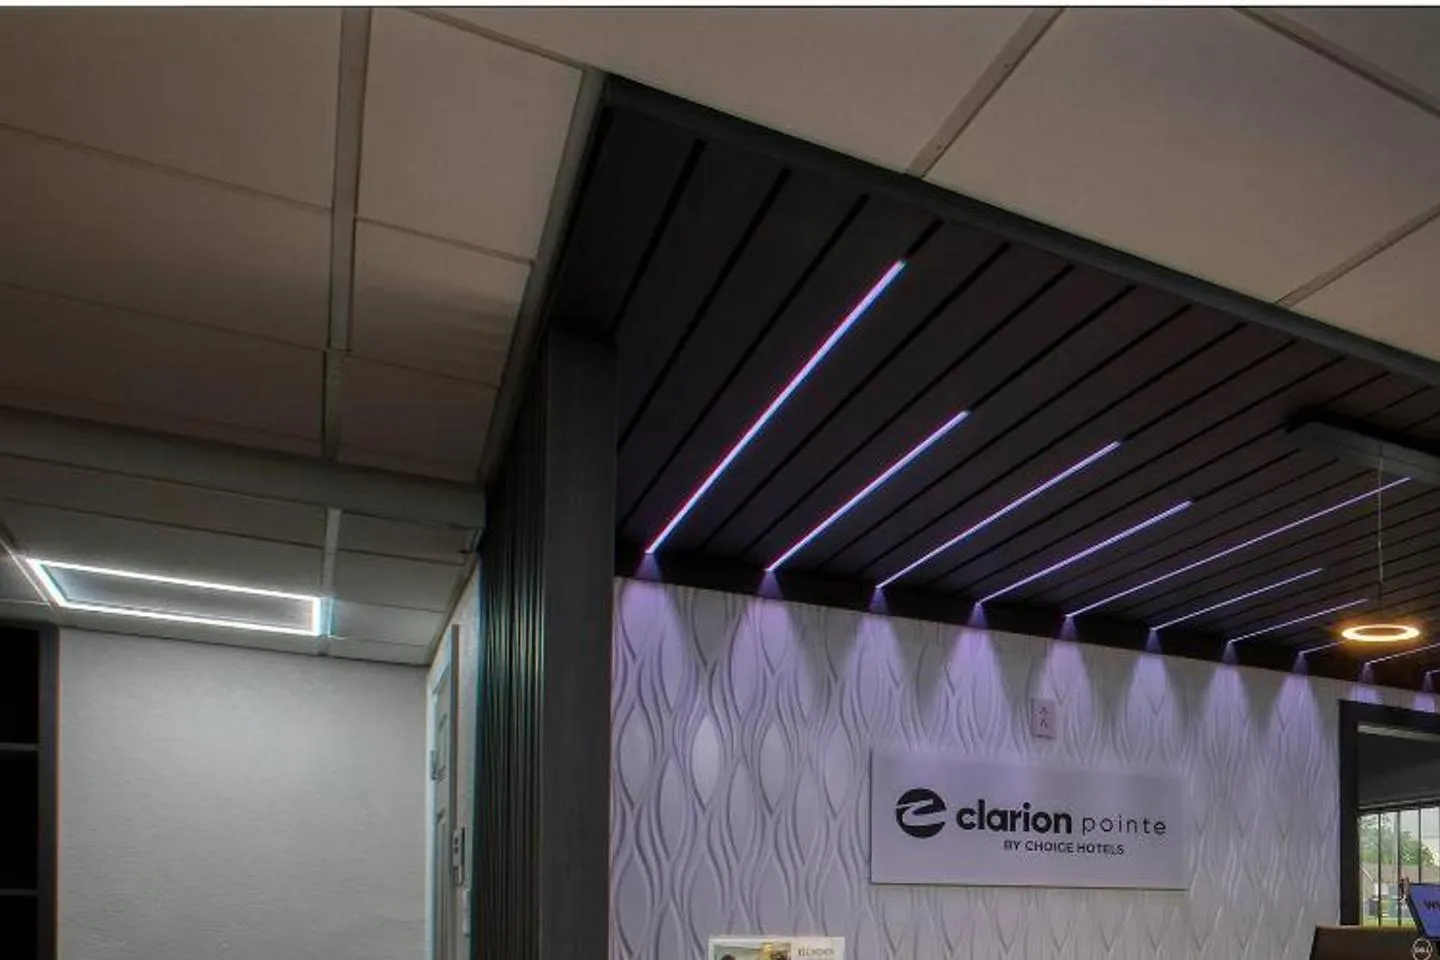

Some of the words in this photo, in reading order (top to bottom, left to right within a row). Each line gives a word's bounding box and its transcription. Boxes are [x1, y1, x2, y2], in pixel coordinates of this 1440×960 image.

[956, 799, 1072, 834] clarion
[1082, 815, 1167, 837] pointe
[1004, 840, 1021, 851] BY
[1025, 840, 1074, 854] CHOICE
[1076, 842, 1124, 855] HOTELS
